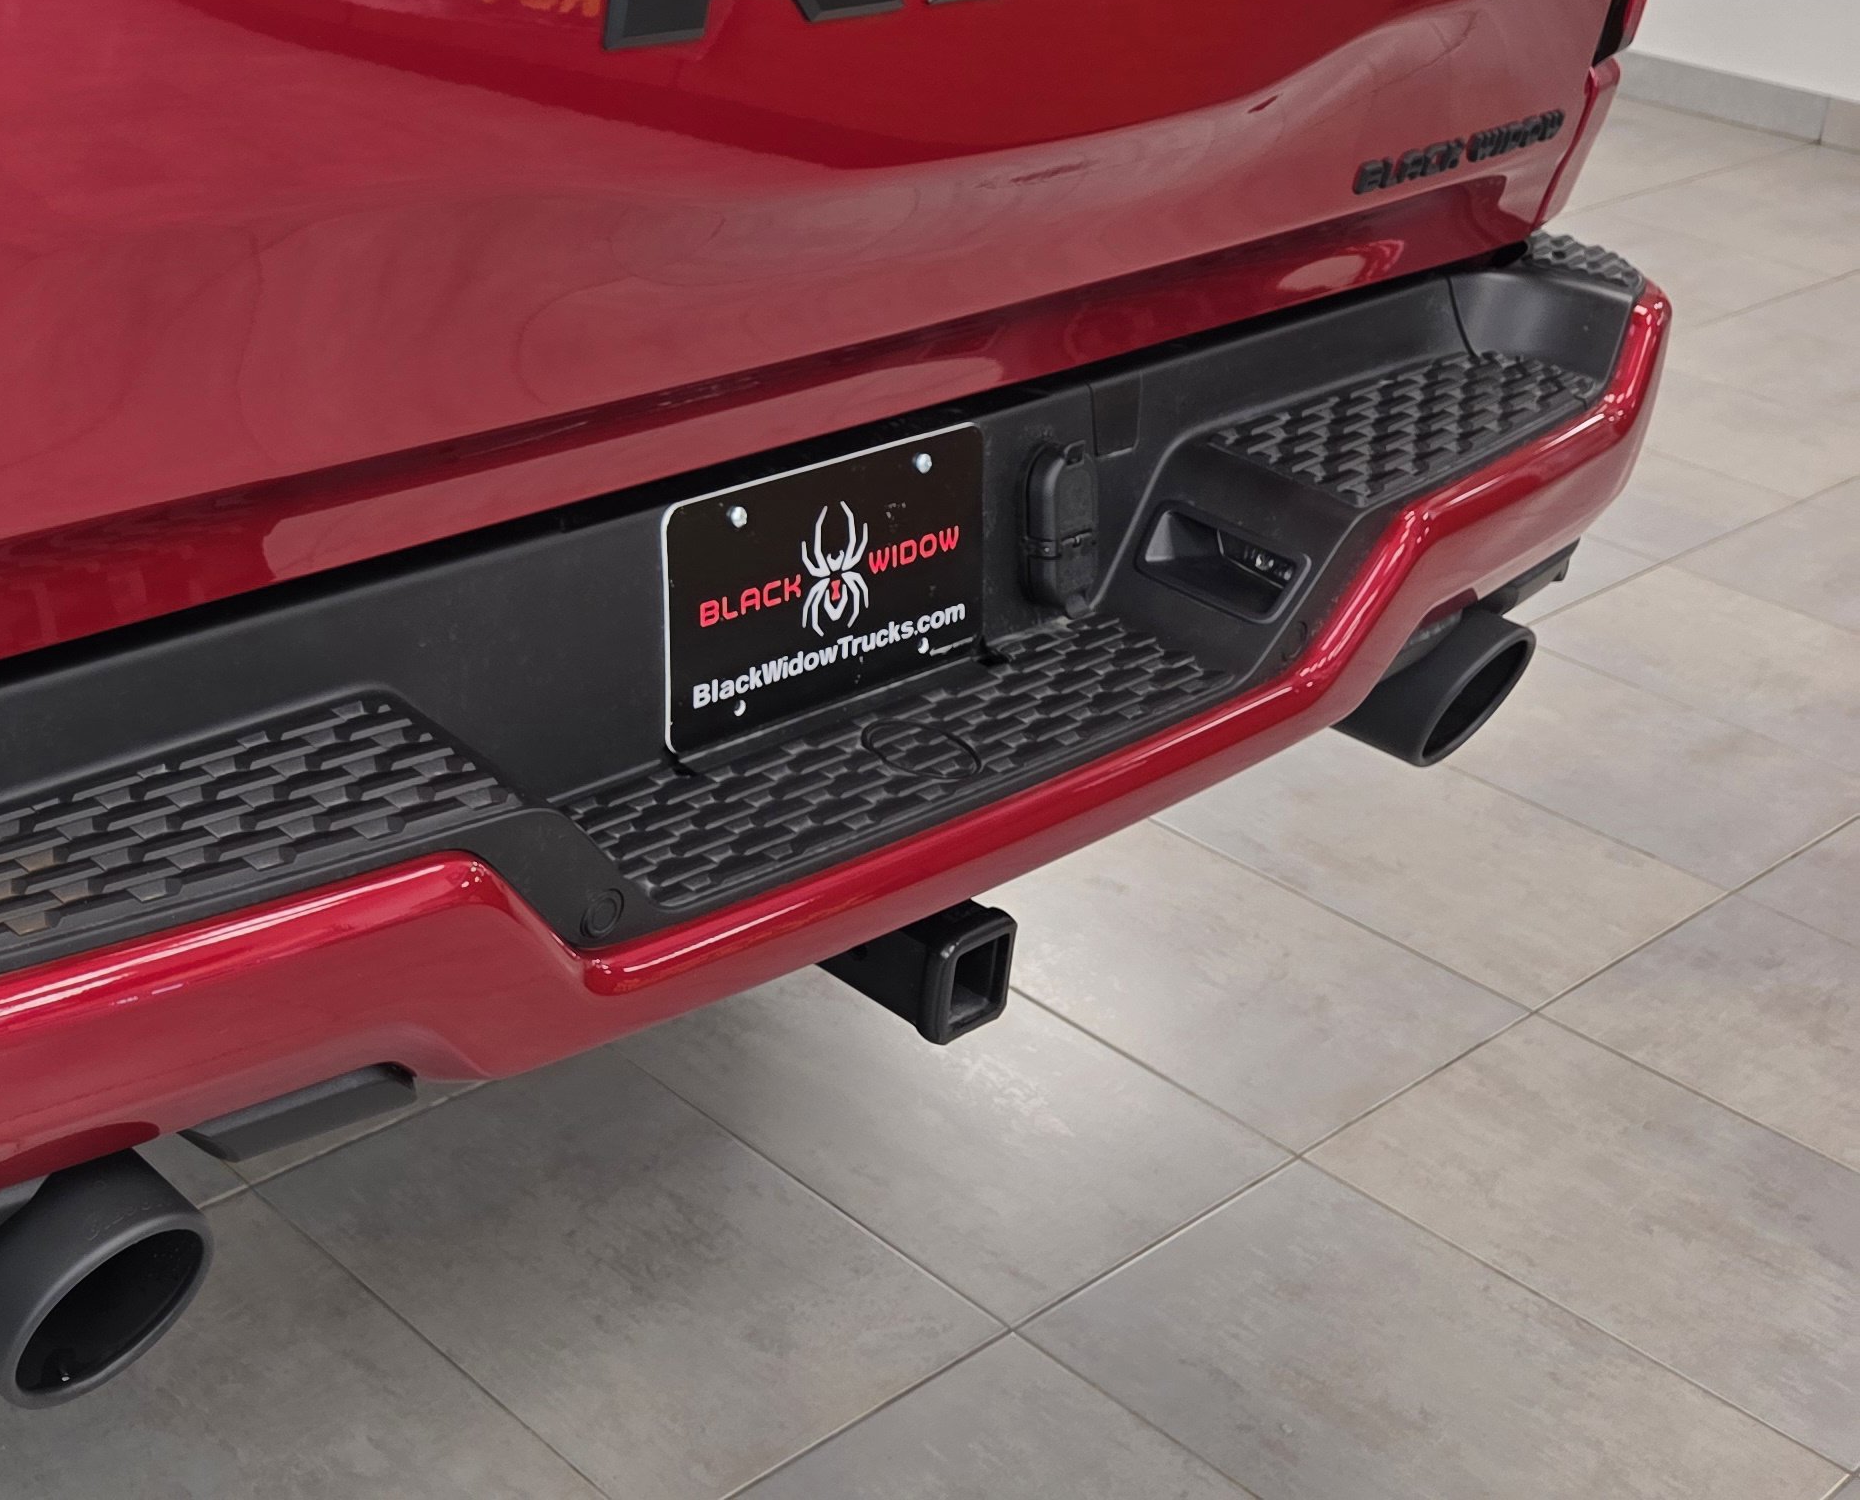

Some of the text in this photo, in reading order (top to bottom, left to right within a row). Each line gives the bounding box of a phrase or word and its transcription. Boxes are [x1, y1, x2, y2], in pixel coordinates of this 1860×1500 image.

[1353, 108, 1565, 195] BLACK WIDOW
[699, 525, 960, 628] BLACK WIDOW
[692, 603, 966, 709] BlackWidowTrucks.com
